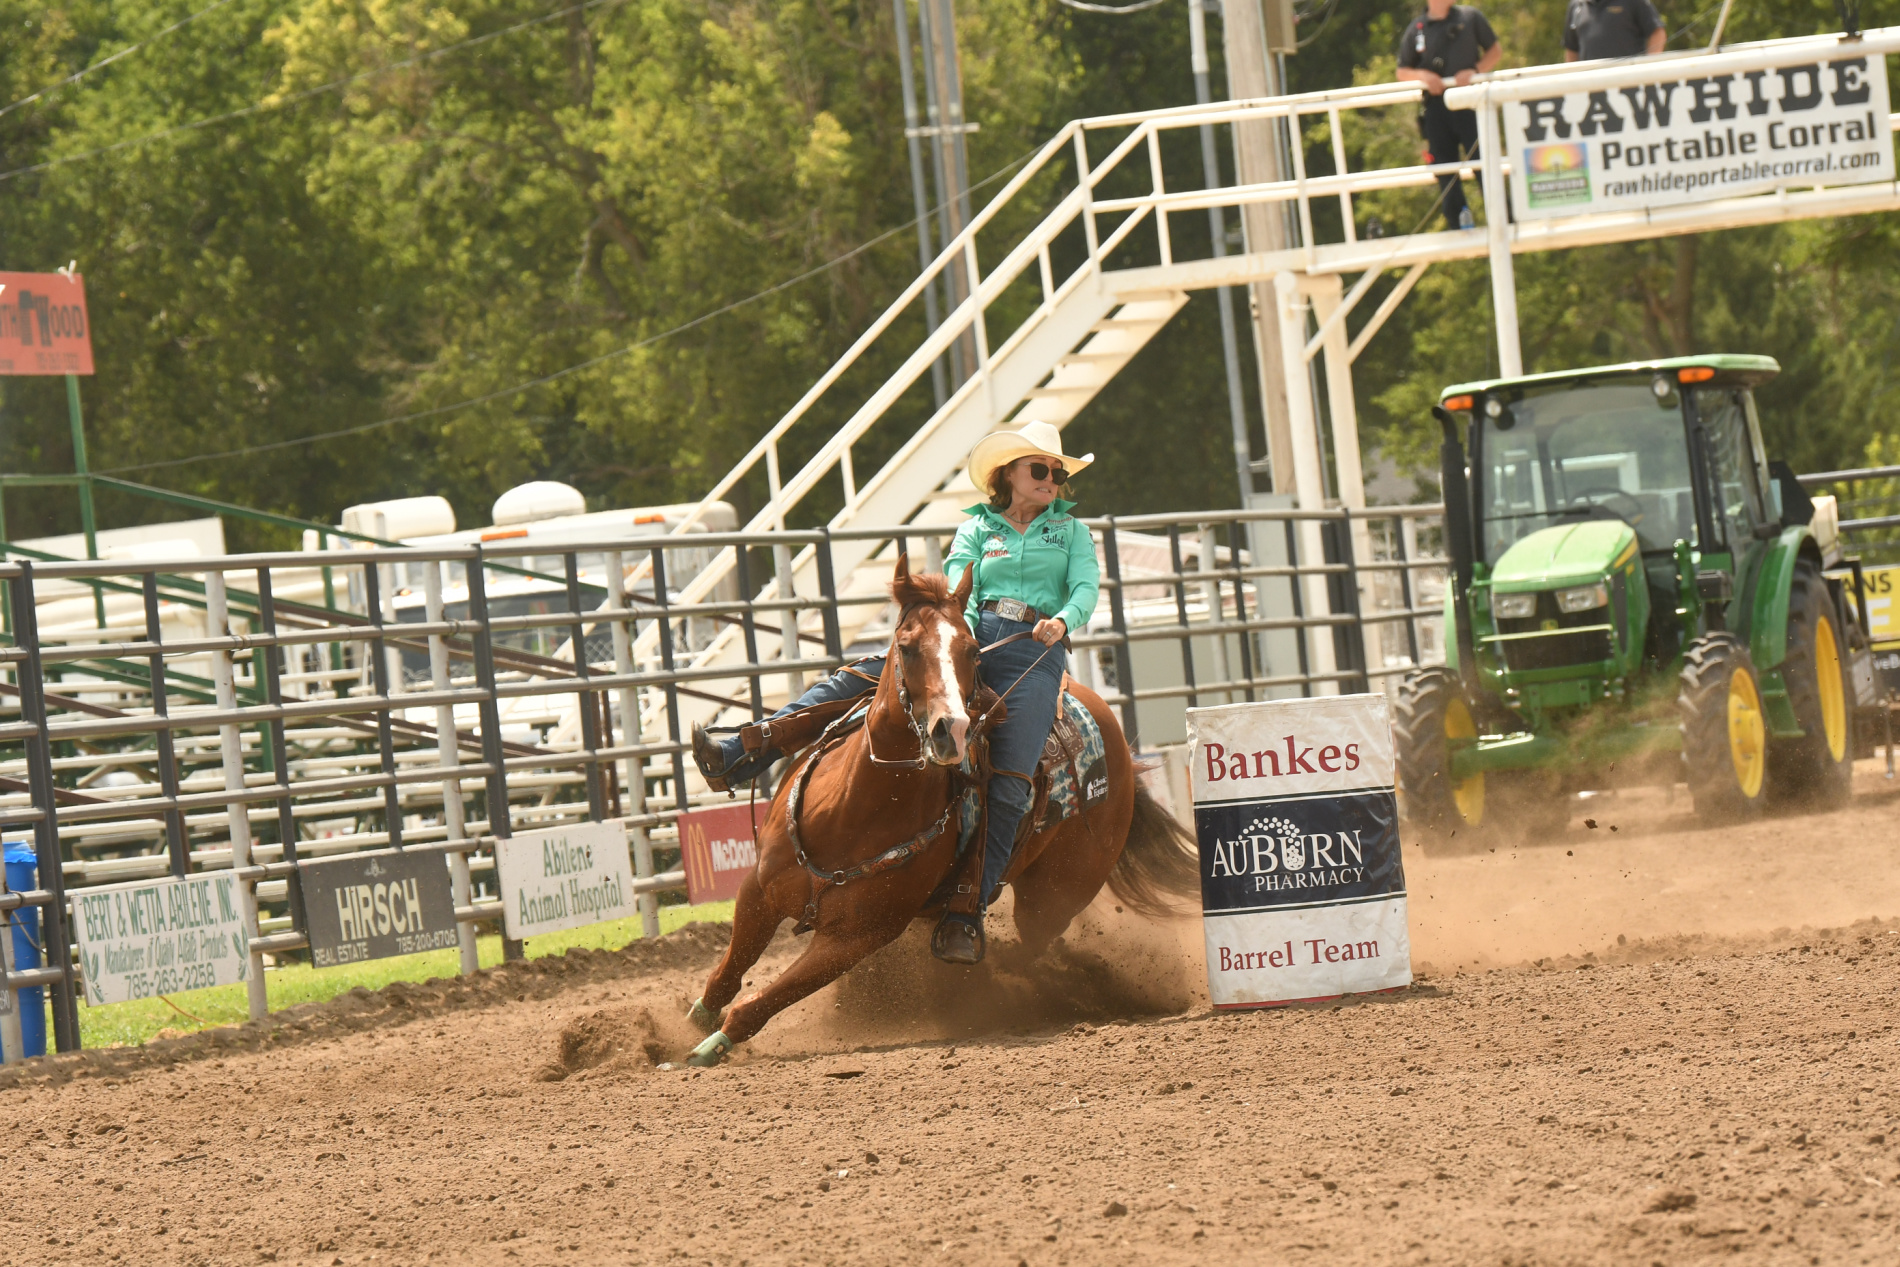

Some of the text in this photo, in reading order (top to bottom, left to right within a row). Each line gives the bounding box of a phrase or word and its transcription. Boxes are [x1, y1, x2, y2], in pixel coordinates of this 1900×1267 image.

[1521, 57, 1870, 142] RAWHIDE
[1601, 111, 1876, 170] Portable Corral
[1604, 151, 1881, 197] rawhideportablecorral.com
[1203, 735, 1360, 782] Bankes
[543, 837, 593, 877] Abilene
[1211, 829, 1363, 877] AUBURN
[519, 872, 623, 926] Animal Hospital
[1254, 866, 1365, 892] PHARMACY
[83, 893, 113, 942] BERT
[116, 892, 128, 937] &
[125, 887, 167, 937] WETTA
[335, 877, 424, 942] HIRSCH
[314, 942, 369, 966] REAL ESTATE
[1218, 938, 1380, 972] Barrel Team
[124, 962, 216, 1000] 785-263-2258
